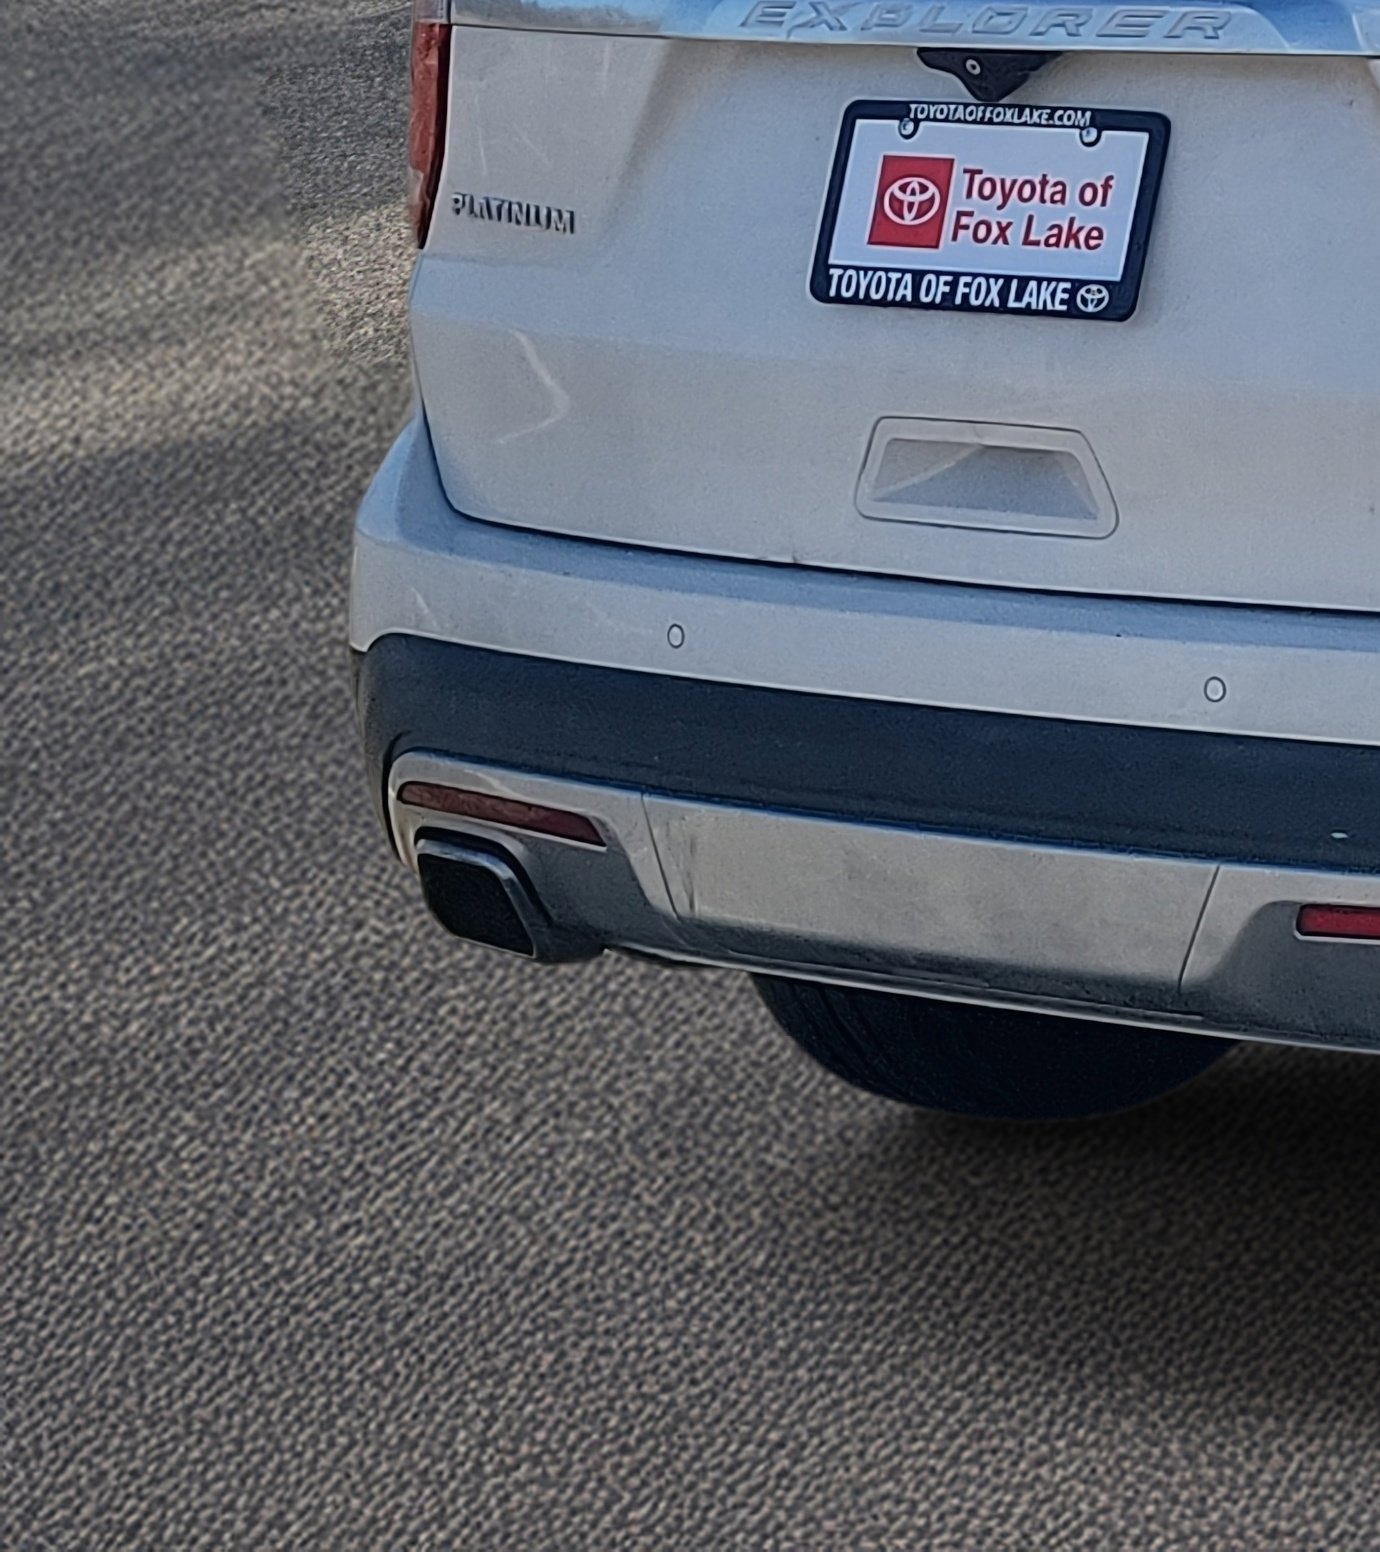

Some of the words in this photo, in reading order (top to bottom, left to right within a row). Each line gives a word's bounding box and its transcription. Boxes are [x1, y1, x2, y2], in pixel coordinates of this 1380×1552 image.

[740, 0, 1232, 40] EXPLORER
[909, 103, 1091, 127] TOYOTAOFFOXLAKE.COM
[963, 168, 1067, 210] Toyota
[1078, 175, 1114, 207] of
[452, 192, 575, 234] PLATINUM
[951, 210, 1013, 246] Fox
[1022, 214, 1104, 251] Lake
[829, 268, 912, 302] TOYOTA
[918, 273, 954, 305] OF
[955, 275, 1004, 307] FOX
[1007, 279, 1071, 311] LAKE
